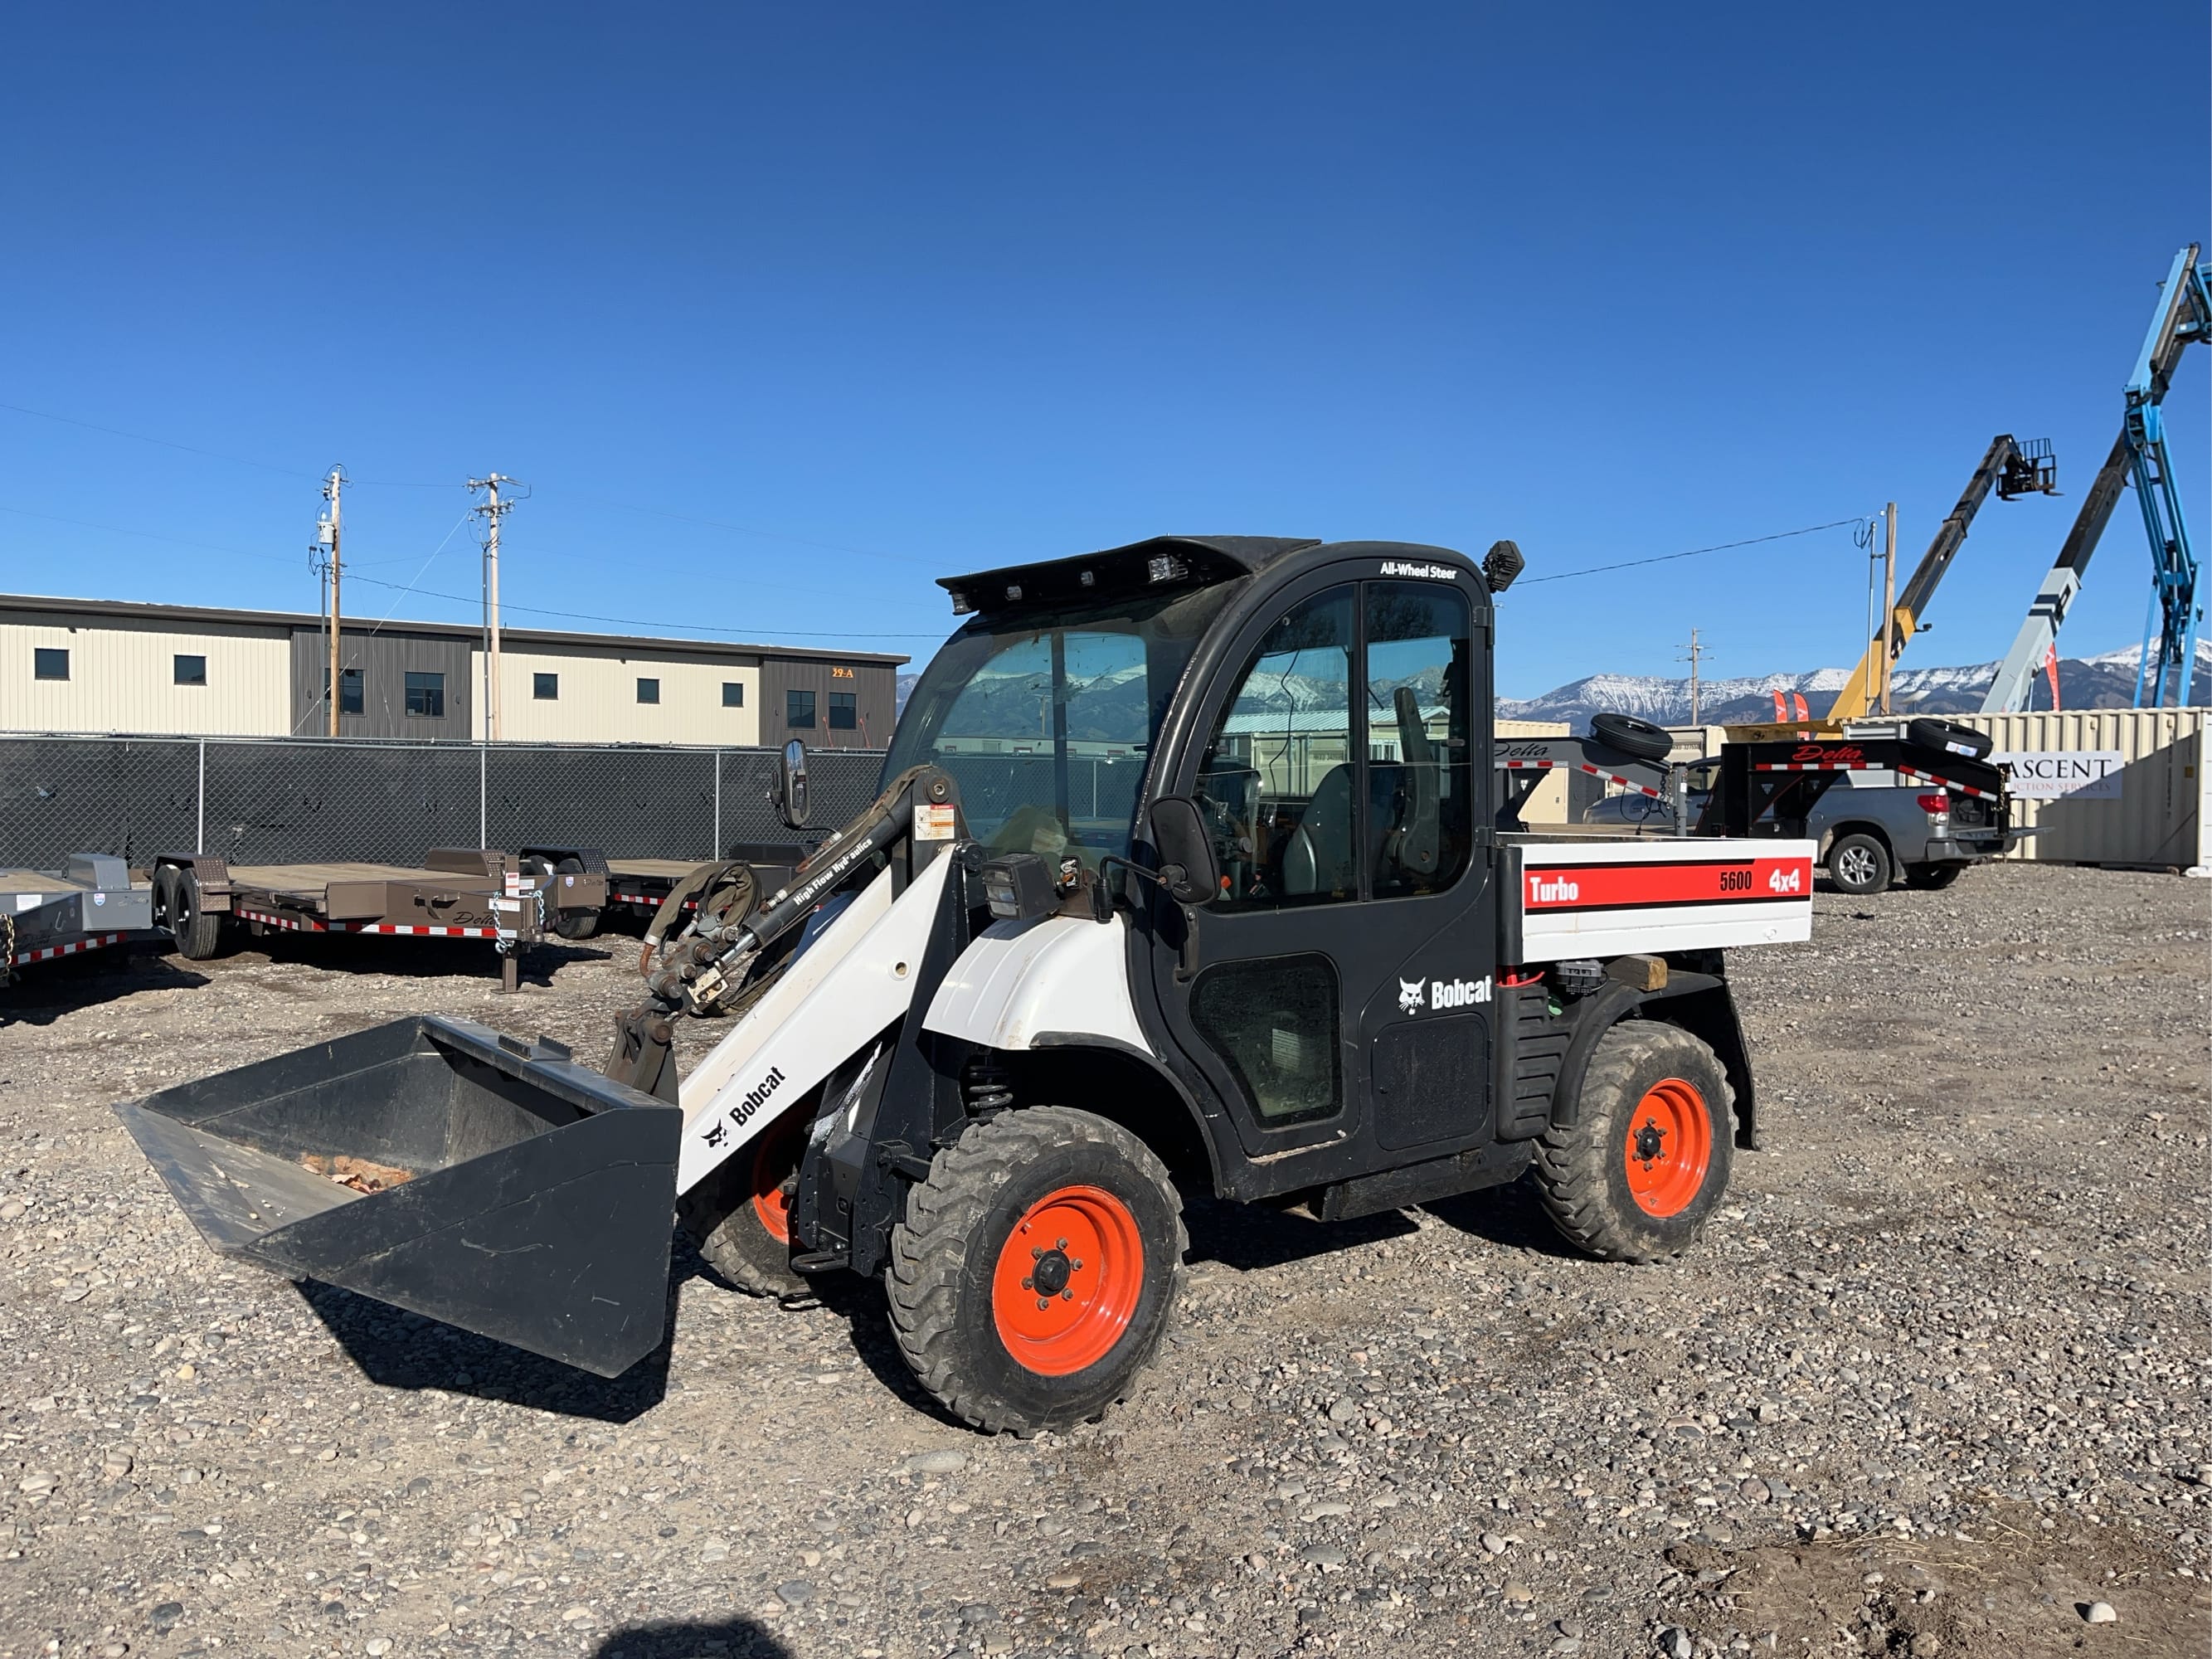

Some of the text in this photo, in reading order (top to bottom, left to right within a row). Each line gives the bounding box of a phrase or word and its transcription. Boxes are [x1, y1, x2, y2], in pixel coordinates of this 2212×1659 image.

[1380, 562, 1457, 579] All-Wheel Steer
[1791, 745, 1864, 761] Delta
[2058, 781, 2111, 792] SERVICES
[793, 886, 815, 906] High
[811, 870, 834, 890] Flow
[1529, 868, 1801, 902] Turbo 5600 4x4
[1431, 975, 1492, 1010] Bobcat
[728, 1065, 786, 1127] Bobcat
